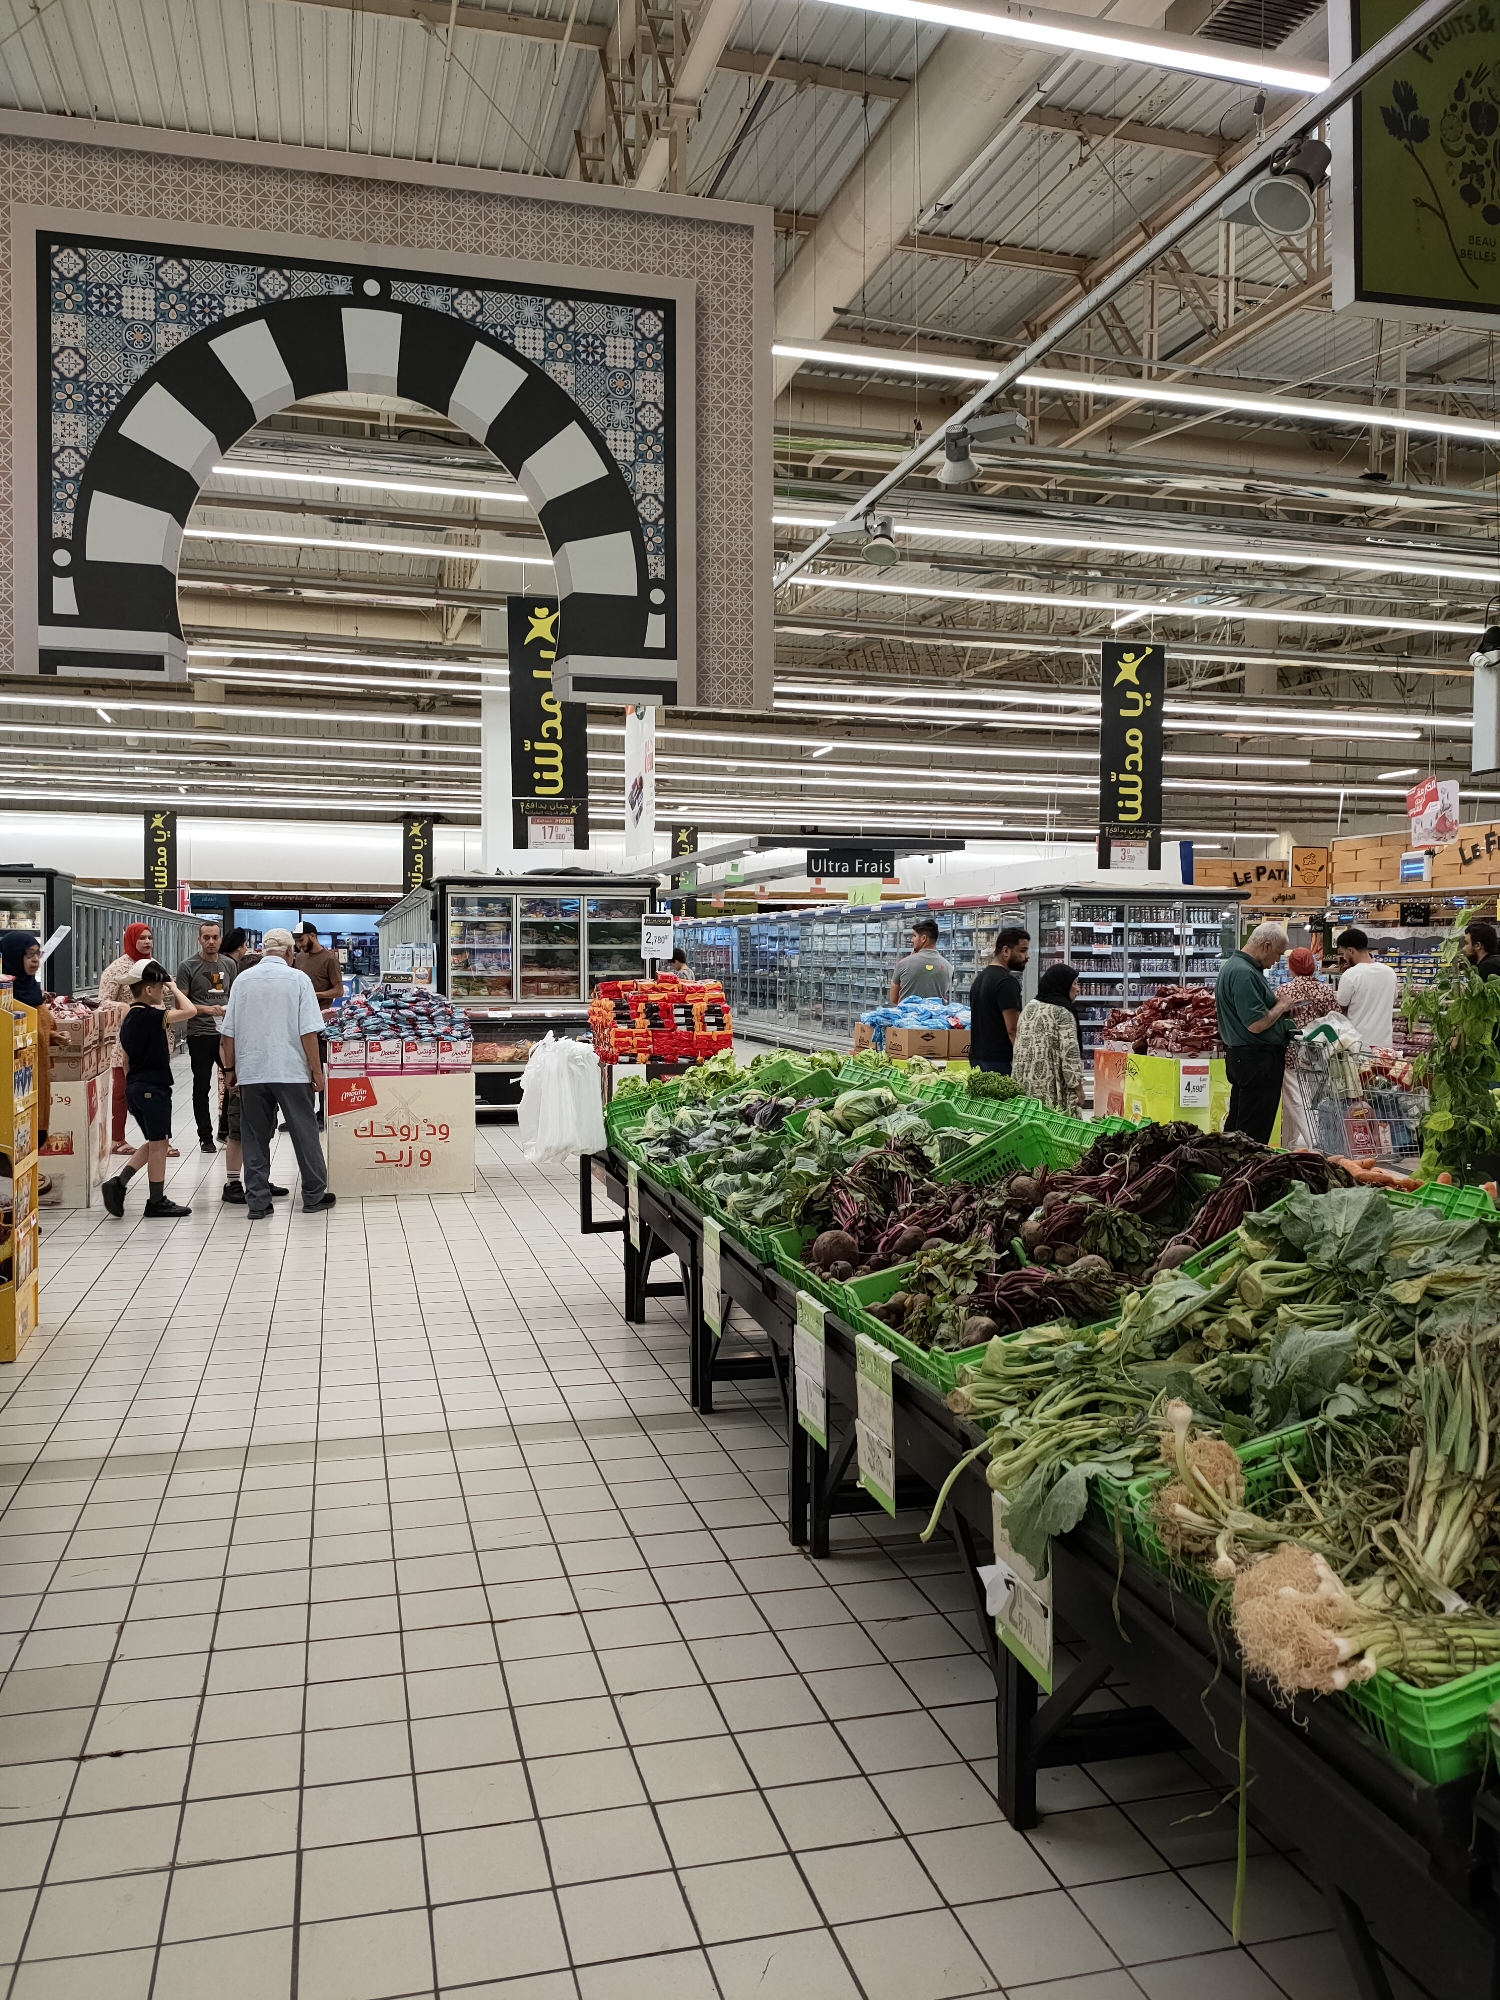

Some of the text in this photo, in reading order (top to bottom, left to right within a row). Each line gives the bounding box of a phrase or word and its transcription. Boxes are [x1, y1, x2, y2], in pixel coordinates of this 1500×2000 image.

[1412, 5, 1495, 63] FRUITS &
[1469, 235, 1496, 248] BEAU
[1460, 249, 1497, 262] BELLES
[541, 825, 555, 840] 17
[1120, 847, 1126, 861] 3
[811, 858, 892, 873] Ultra Frais
[1271, 893, 1296, 903] الحلواني
[341, 1089, 366, 1101] Moulin
[350, 1095, 366, 1103] d'Or
[353, 1120, 419, 1142] روحك
